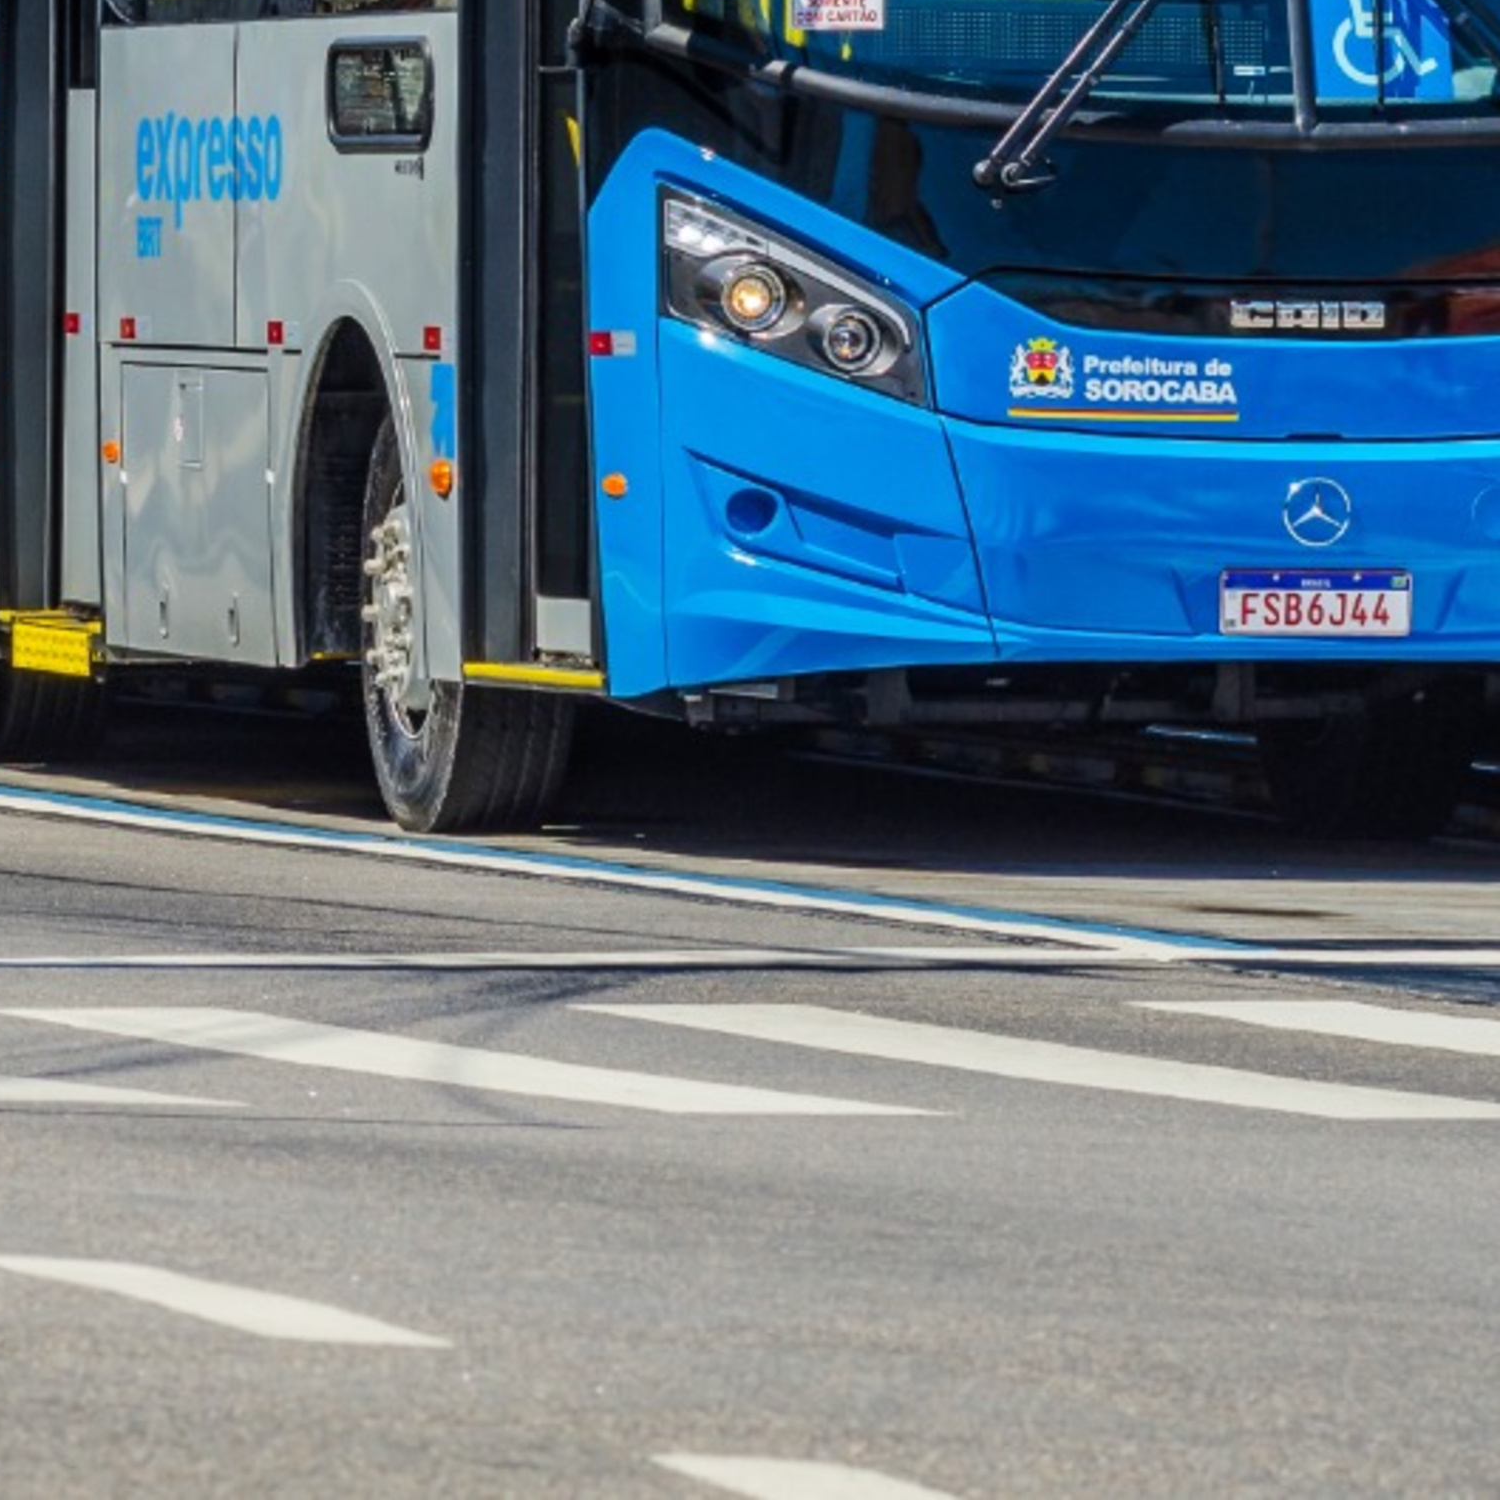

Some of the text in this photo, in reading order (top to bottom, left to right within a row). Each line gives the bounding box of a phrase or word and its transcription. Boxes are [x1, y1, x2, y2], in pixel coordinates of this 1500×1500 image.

[136, 109, 283, 230] expresso
[1083, 355, 1233, 377] Prefeitura de
[1084, 379, 1238, 404] SOROCABA
[1241, 592, 1391, 626] FSB6J44
